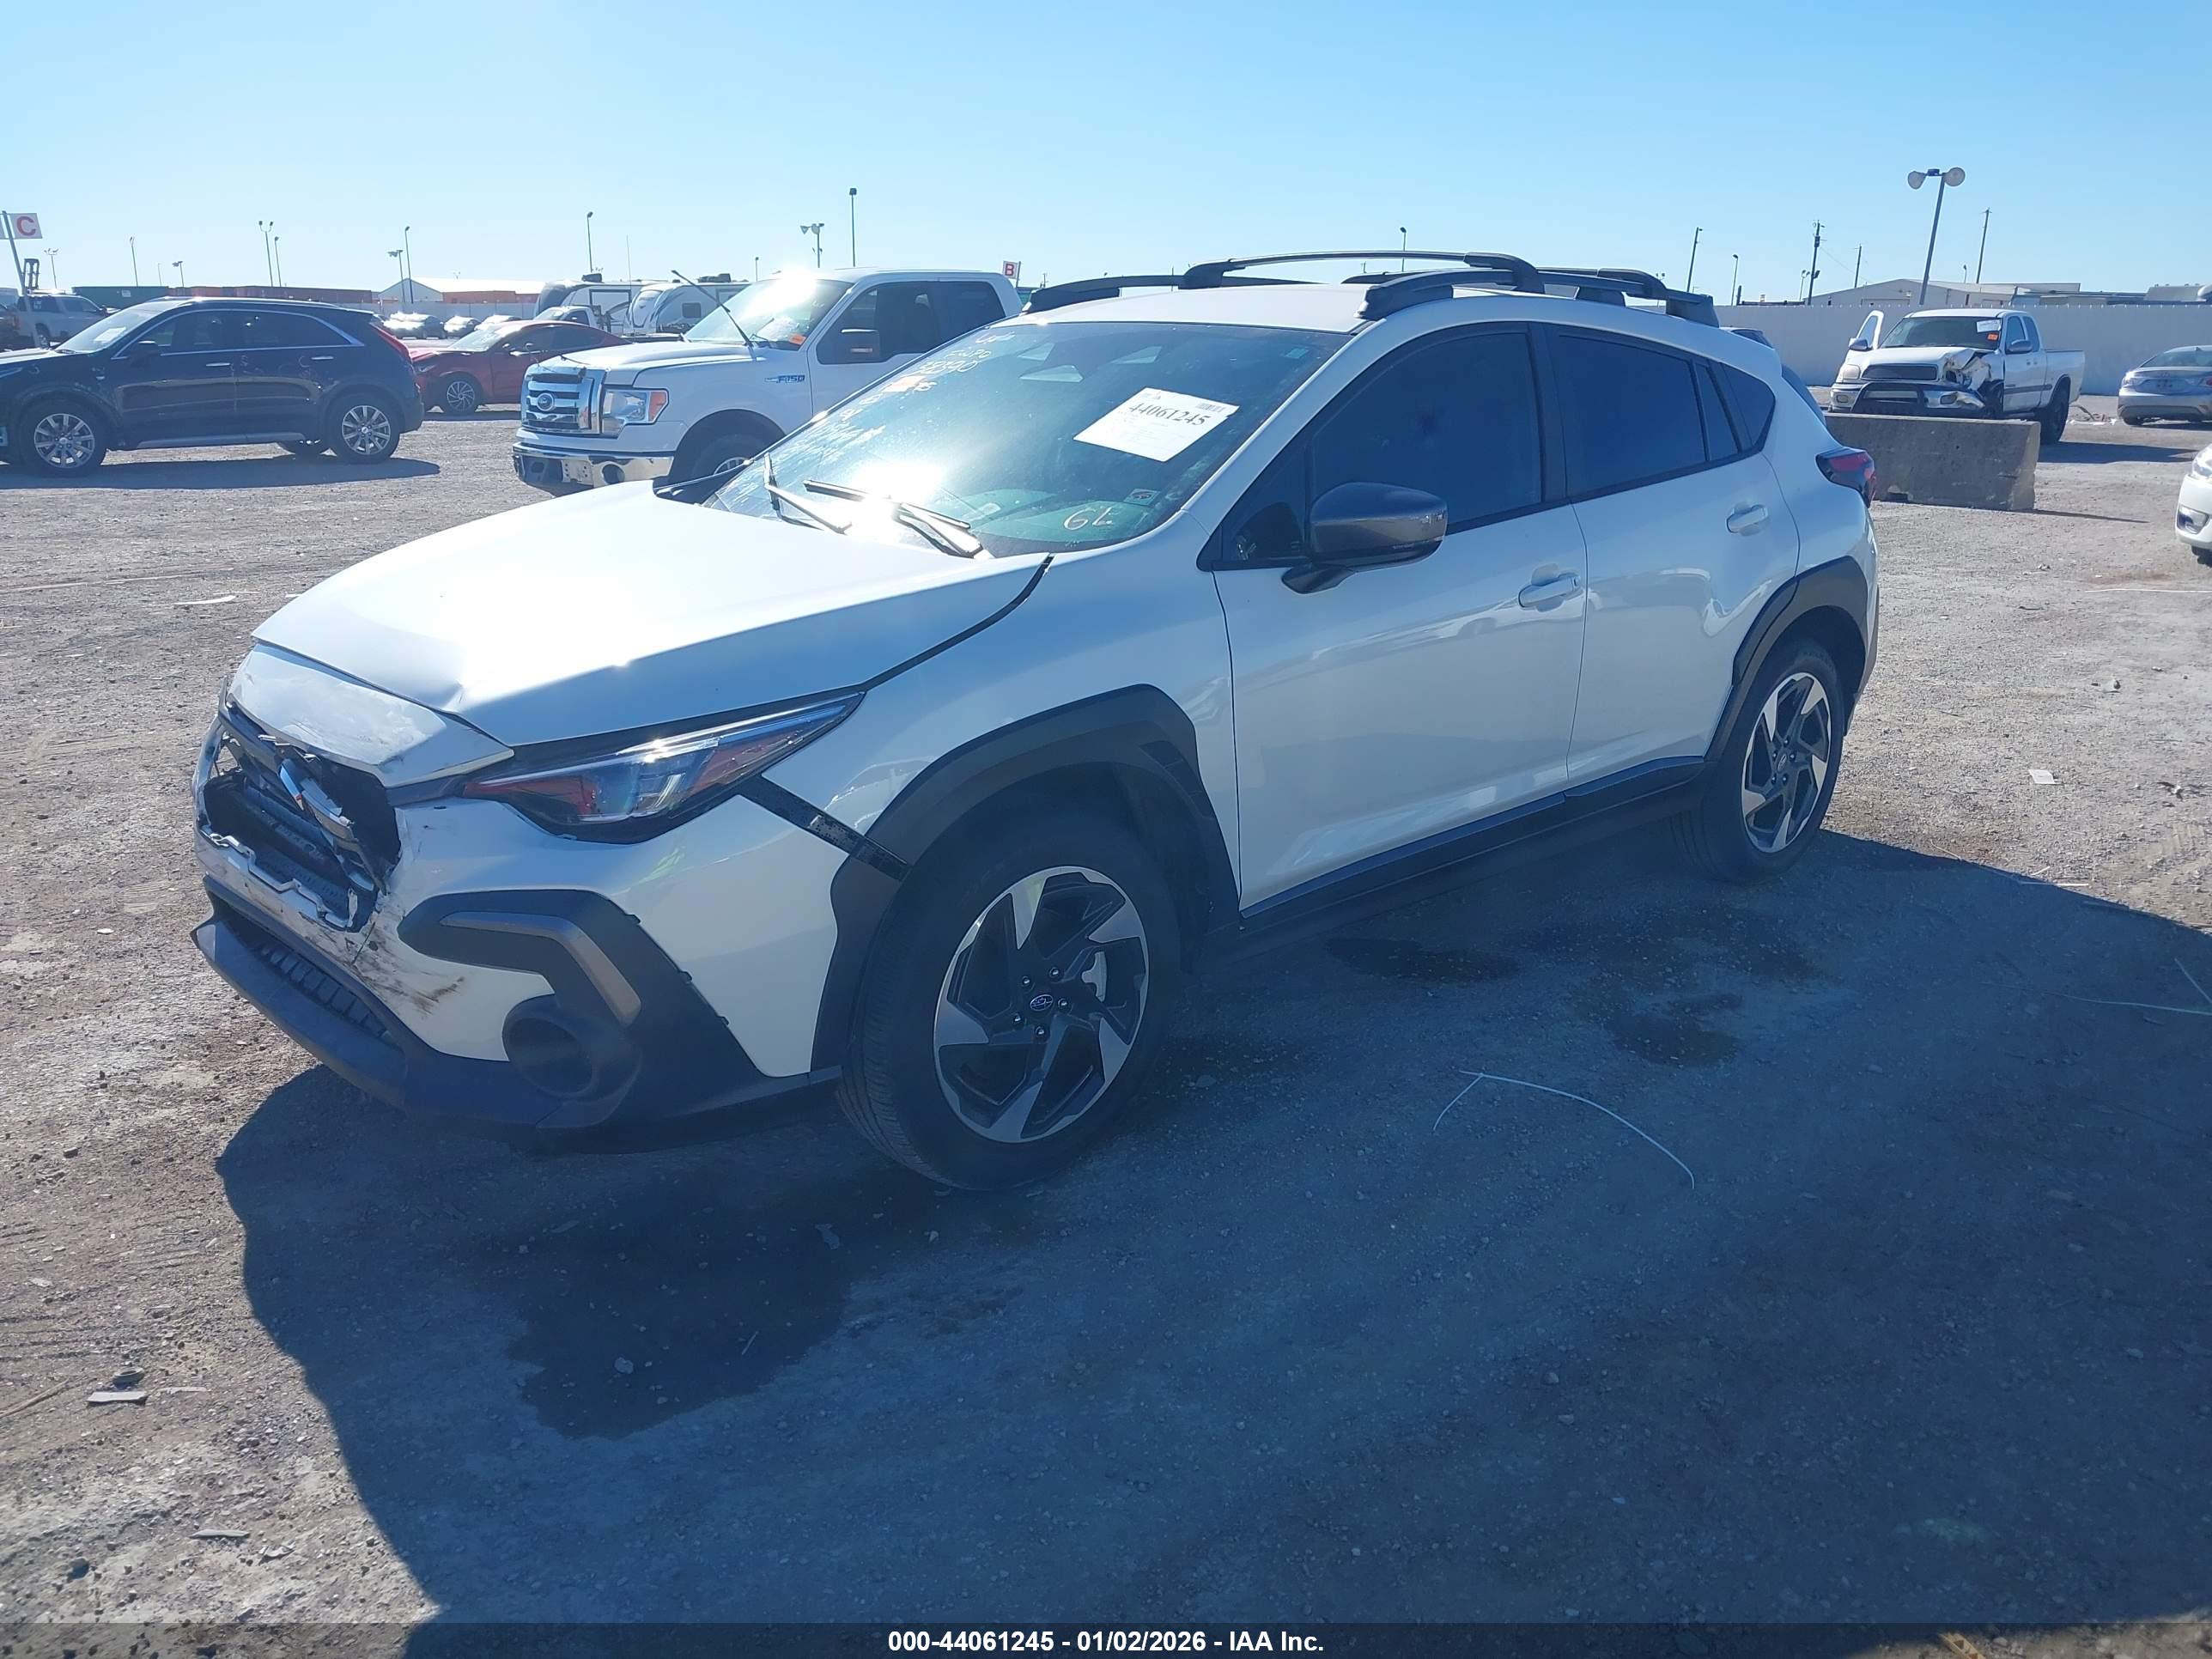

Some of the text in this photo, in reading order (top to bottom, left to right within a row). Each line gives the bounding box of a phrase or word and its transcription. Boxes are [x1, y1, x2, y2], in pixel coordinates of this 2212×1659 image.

[17, 216, 36, 236] C
[1005, 263, 1014, 276] B
[1128, 403, 1212, 426] 44061245
